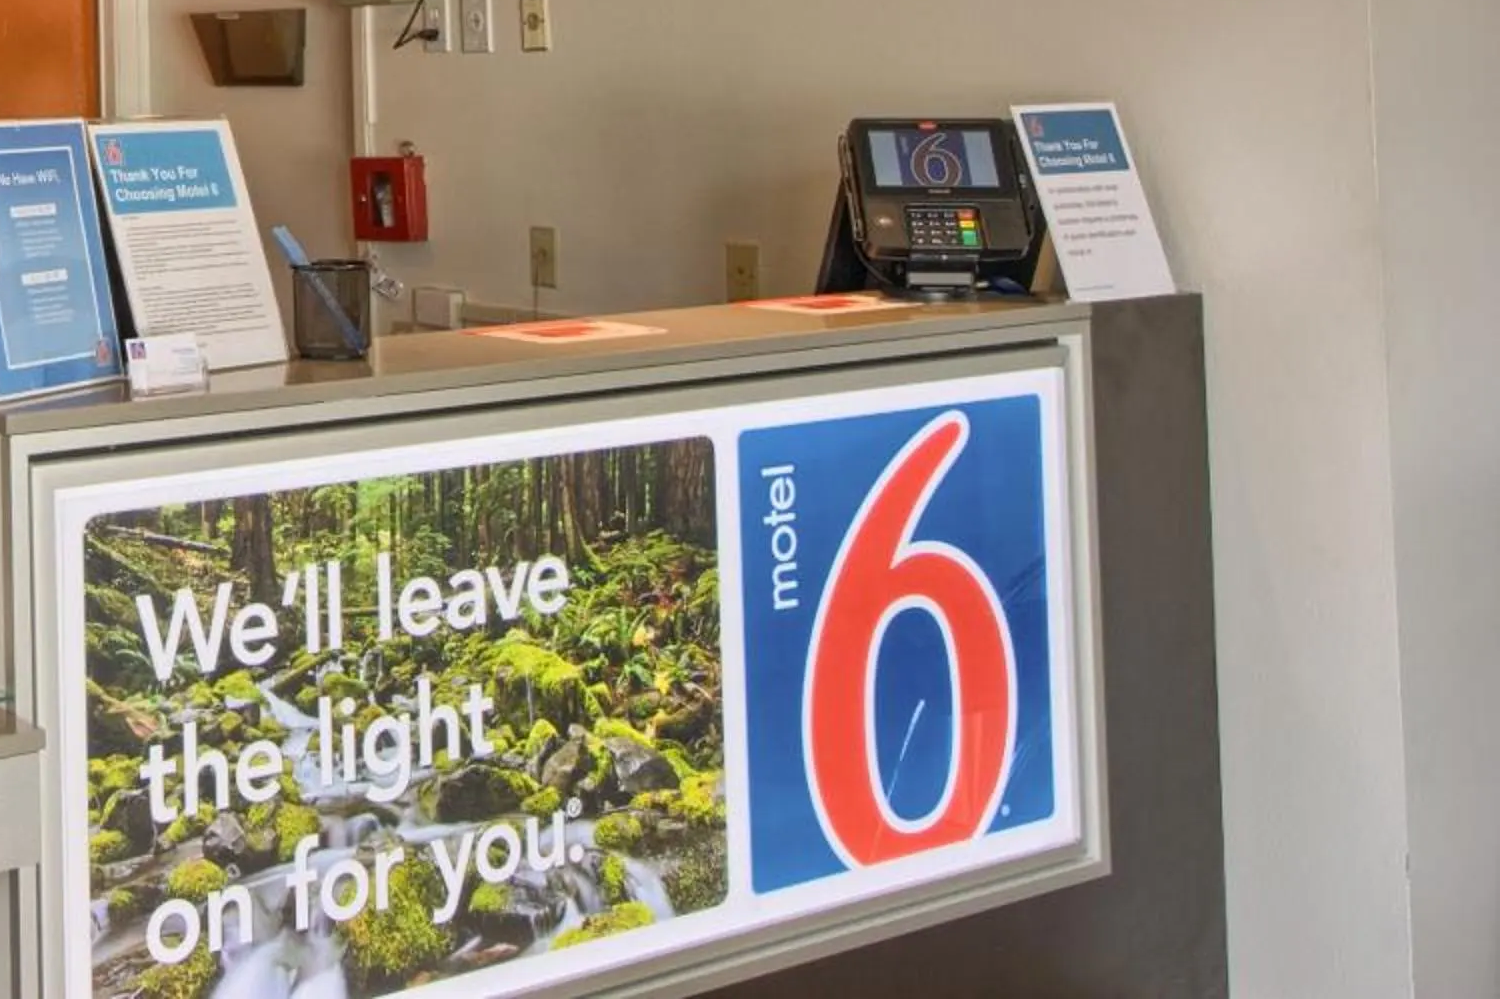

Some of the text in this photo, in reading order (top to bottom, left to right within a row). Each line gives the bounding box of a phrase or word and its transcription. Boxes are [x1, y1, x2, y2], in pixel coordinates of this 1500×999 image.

[109, 164, 199, 183] Thank You For
[115, 187, 177, 202] Choosing
[909, 132, 962, 187] 6
[762, 463, 798, 612] motel
[137, 551, 570, 683] We'll leave
[802, 408, 1017, 871] 6
[140, 677, 496, 825] the light
[146, 883, 255, 965] on
[286, 833, 405, 931] for
